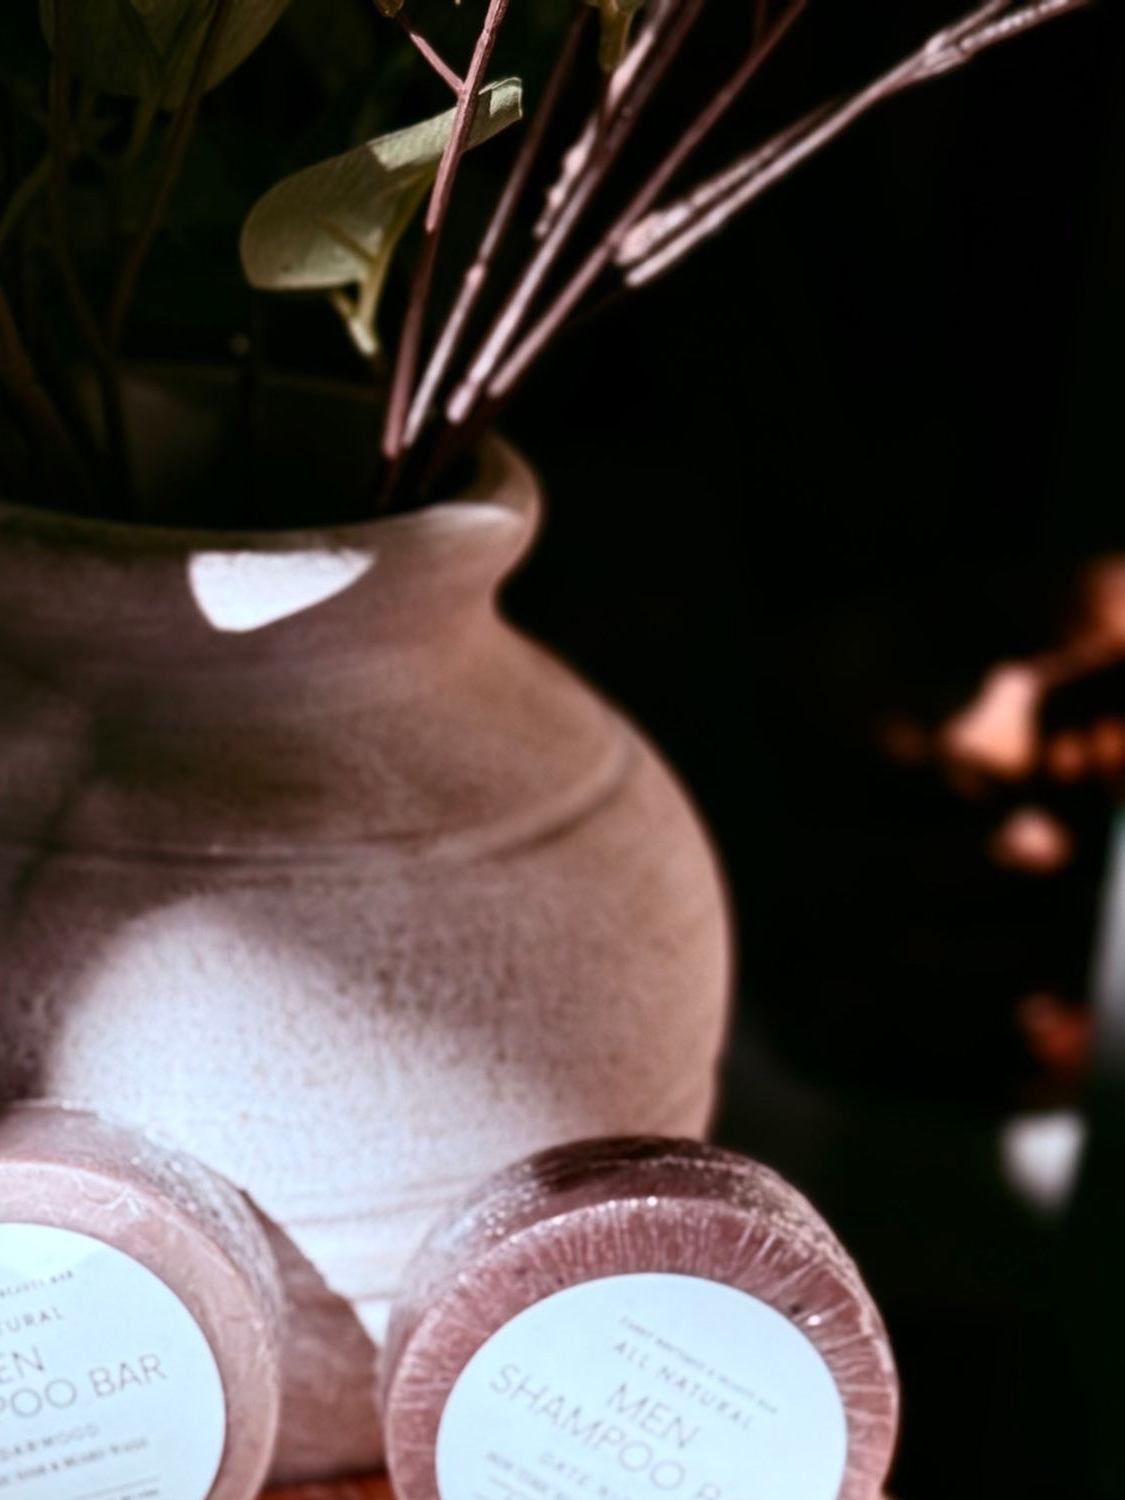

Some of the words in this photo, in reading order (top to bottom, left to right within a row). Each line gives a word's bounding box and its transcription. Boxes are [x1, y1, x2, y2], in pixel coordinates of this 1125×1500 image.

[88, 1352, 169, 1399] BAR
[605, 1381, 701, 1450] MEN
[613, 1340, 650, 1371] ALL
[655, 1364, 754, 1431] NATURAL
[488, 1362, 687, 1492] SHAMPOO
